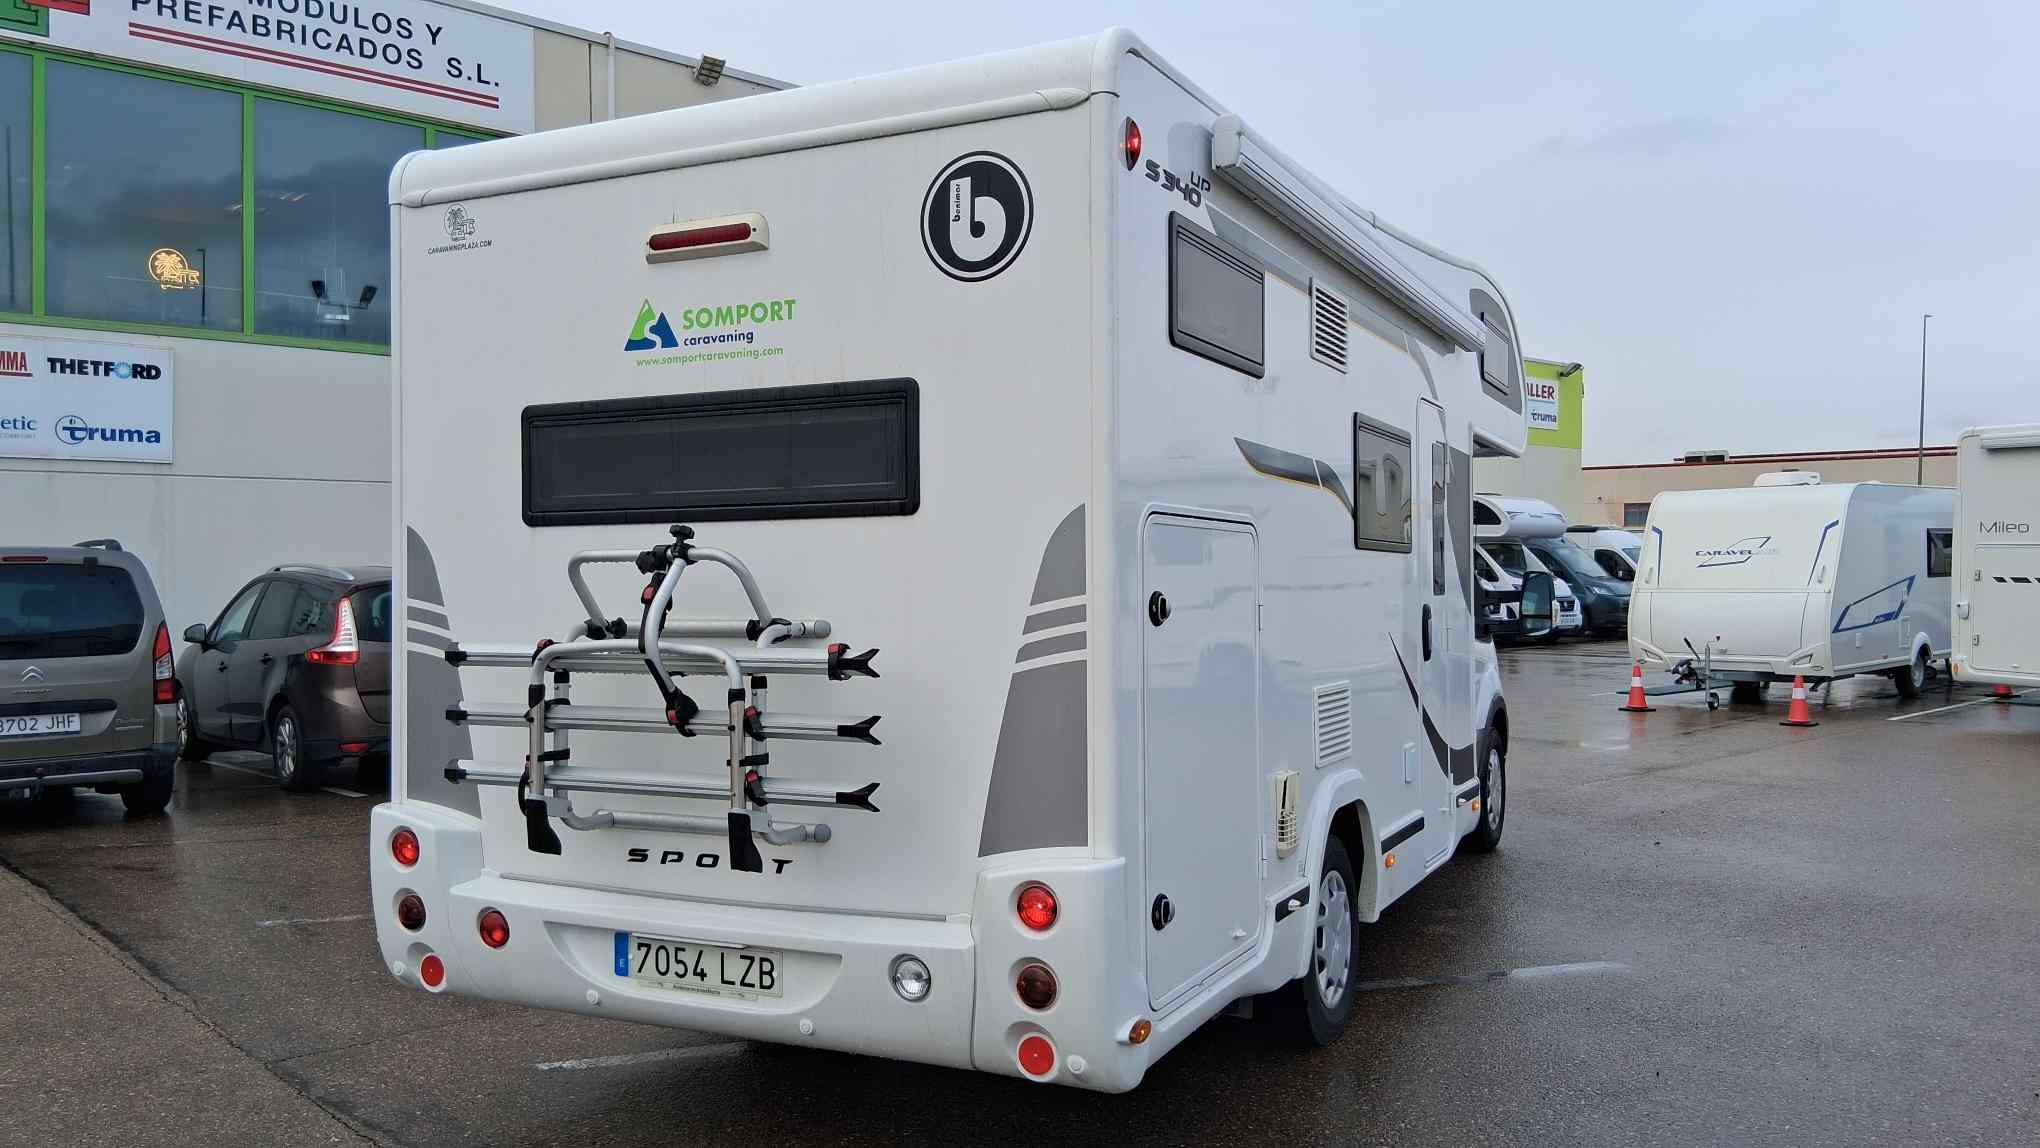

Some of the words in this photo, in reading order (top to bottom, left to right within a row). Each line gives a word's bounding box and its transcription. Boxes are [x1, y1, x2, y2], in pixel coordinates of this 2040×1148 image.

[131, 0, 423, 69] PREFABRICADOS
[446, 57, 499, 87] S.L.
[425, 23, 443, 45] Y
[1145, 158, 1160, 182] S
[1161, 169, 1201, 208] 340
[1191, 171, 1210, 192] UP
[682, 299, 796, 330] SOMPORT
[684, 329, 754, 346] caravaning
[636, 346, 784, 366] www.somportcaravaning.com
[47, 357, 161, 380] THETFORD
[1531, 411, 1557, 422] truma
[62, 425, 161, 443] truma
[1980, 521, 2030, 533] Mileo
[46, 714, 77, 730] JHF
[627, 848, 793, 874] SPOT
[637, 942, 707, 982] 7054
[720, 952, 775, 990] LZB
